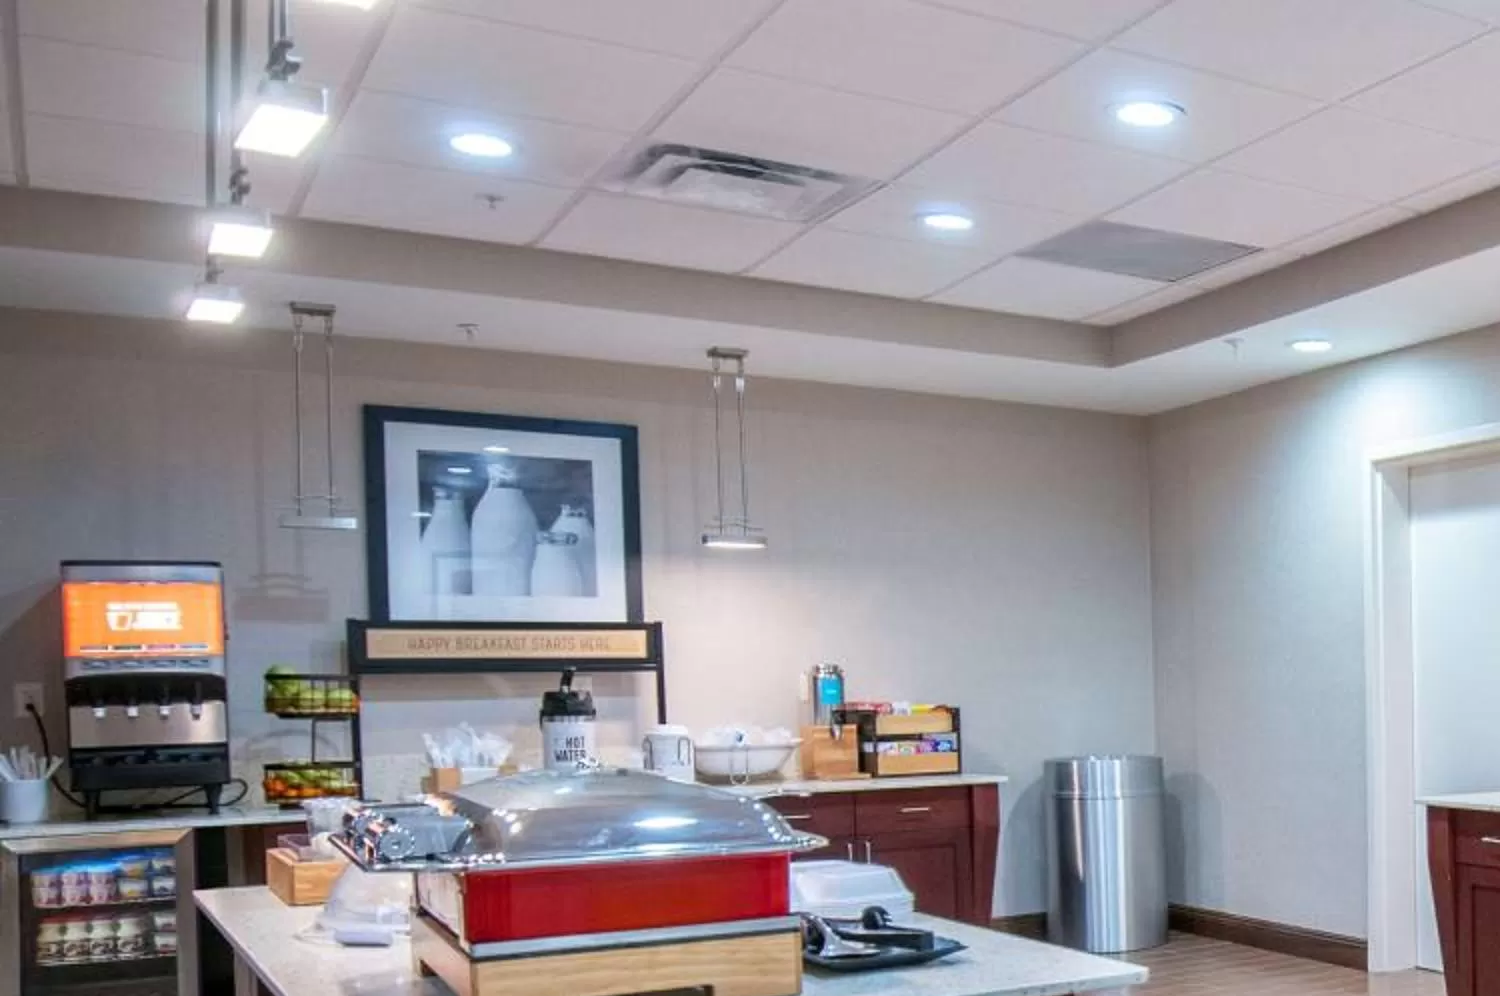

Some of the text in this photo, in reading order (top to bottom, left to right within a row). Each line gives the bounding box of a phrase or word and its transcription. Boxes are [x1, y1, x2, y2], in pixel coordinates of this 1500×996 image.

[406, 636, 450, 652] HAPPY
[456, 636, 526, 652] BREAKFAST
[531, 636, 577, 652] STARTS
[565, 735, 585, 749] HOT
[554, 749, 587, 763] WATER
